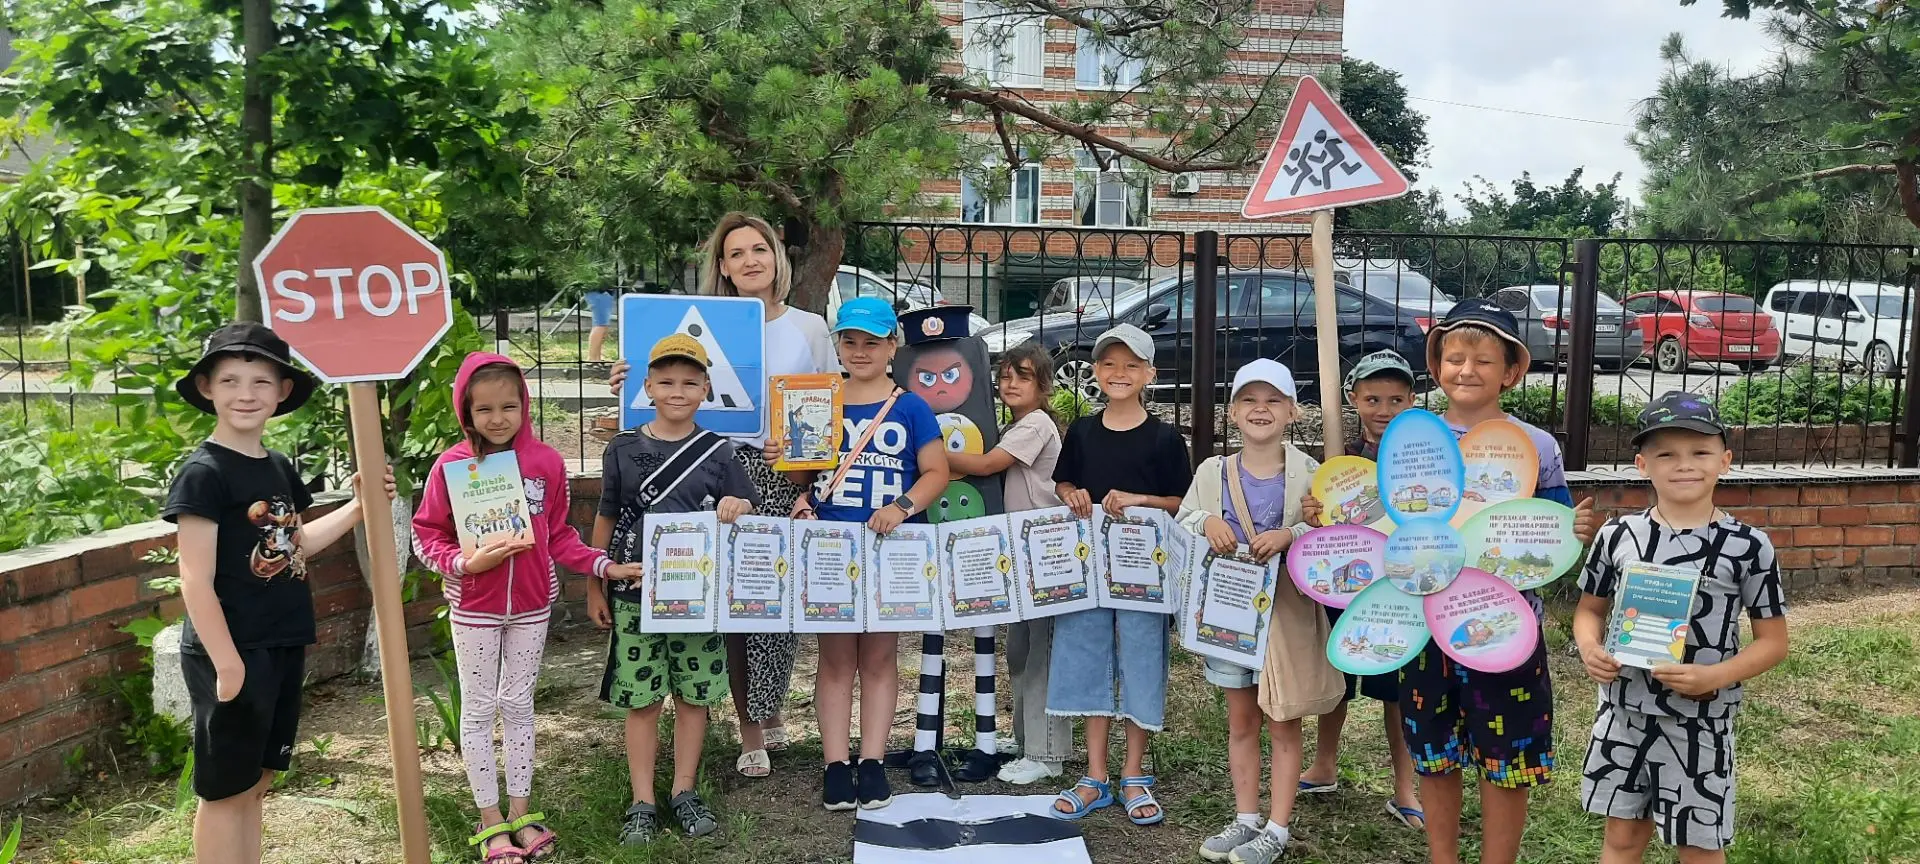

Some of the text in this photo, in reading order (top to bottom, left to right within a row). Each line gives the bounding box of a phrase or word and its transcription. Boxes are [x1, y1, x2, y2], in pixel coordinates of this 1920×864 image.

[272, 262, 440, 323] STOP
[462, 483, 515, 499] ПЕШЕХОД
[665, 547, 694, 557] ПРАВИЛА
[661, 571, 696, 582] ДВИЖЕНИЯ
